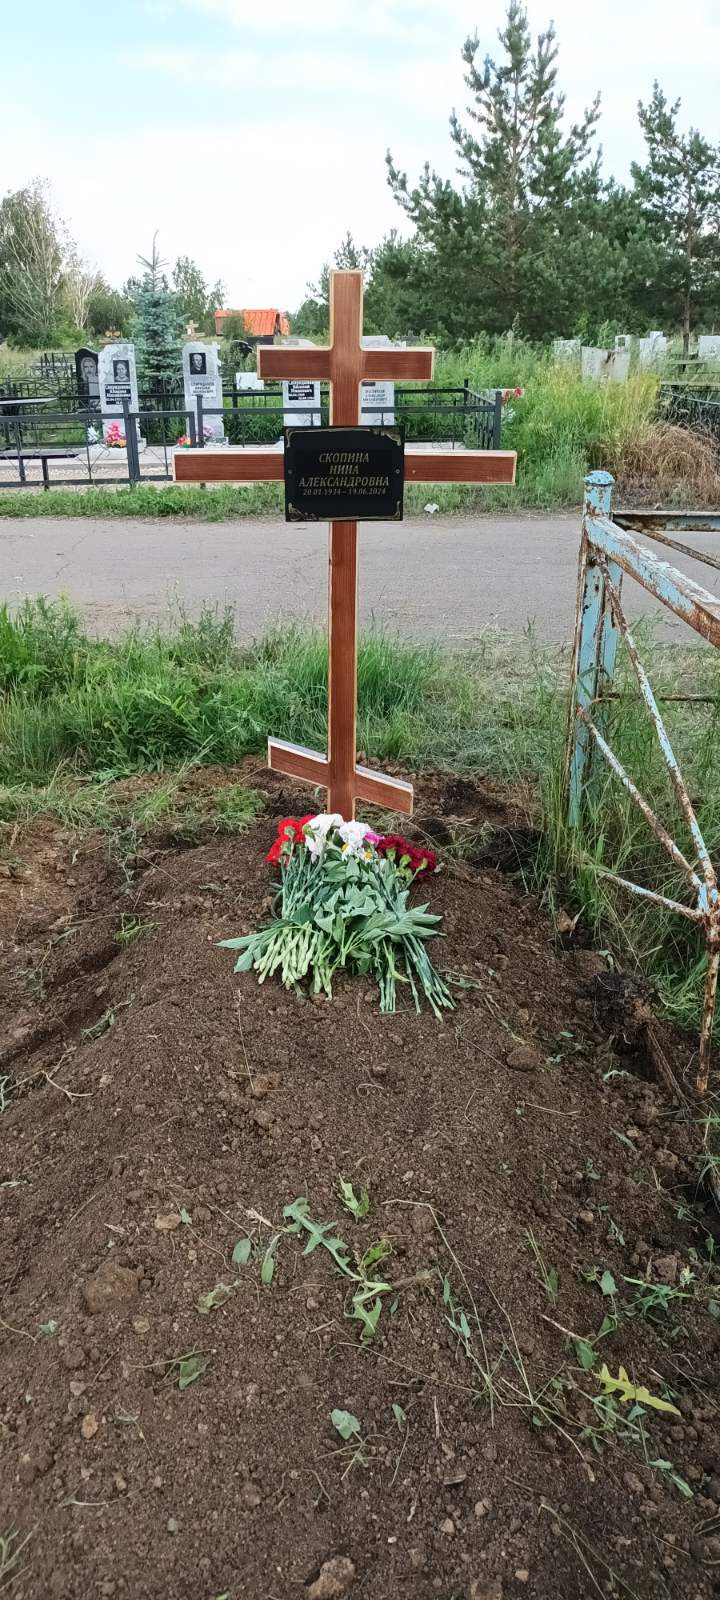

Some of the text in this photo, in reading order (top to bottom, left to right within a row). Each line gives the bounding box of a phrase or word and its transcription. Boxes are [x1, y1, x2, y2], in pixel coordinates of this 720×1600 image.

[319, 453, 369, 463] СКОПИНА
[330, 465, 359, 475] НИНА
[298, 477, 389, 487] АЛЕКСАНДРОВНА
